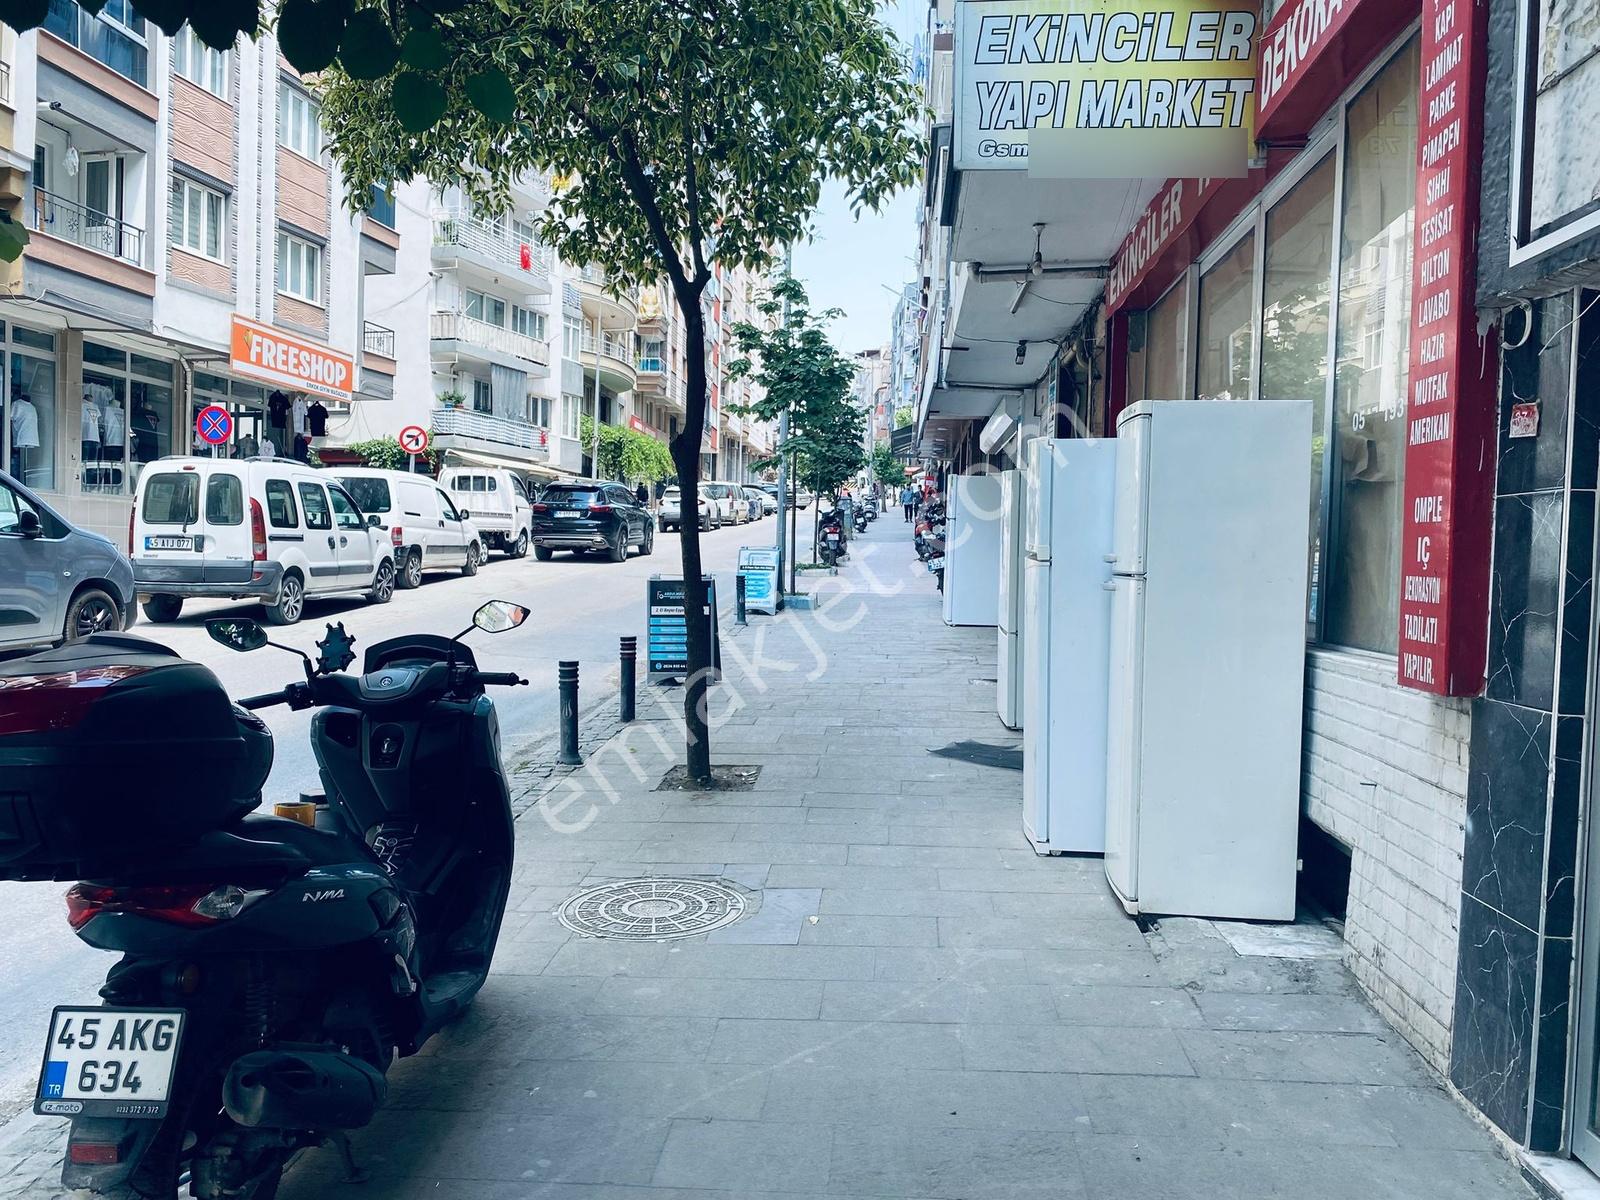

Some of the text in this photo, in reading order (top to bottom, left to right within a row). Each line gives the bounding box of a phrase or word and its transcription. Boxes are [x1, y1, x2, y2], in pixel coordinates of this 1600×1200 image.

[1435, 1, 1455, 43] KAPI
[1425, 33, 1463, 91] LAMİNAT
[976, 78, 1255, 130] YAPI MARKET
[1429, 80, 1456, 127] PARKE
[1422, 118, 1460, 171] PİMAPEN
[1421, 204, 1454, 248] TESİSAT
[1421, 247, 1450, 288] HİLTON
[1418, 289, 1450, 328] LAVABO
[250, 333, 347, 387] FREESHOP
[1420, 332, 1445, 366] HAZIR
[1415, 371, 1448, 407] MUTFAK
[1414, 496, 1443, 524] OMPLE
[1404, 609, 1438, 645] TADİLATI
[57, 1018, 176, 1051] 45 AKG
[48, 1084, 61, 1095] TR
[78, 1060, 142, 1093] 634
